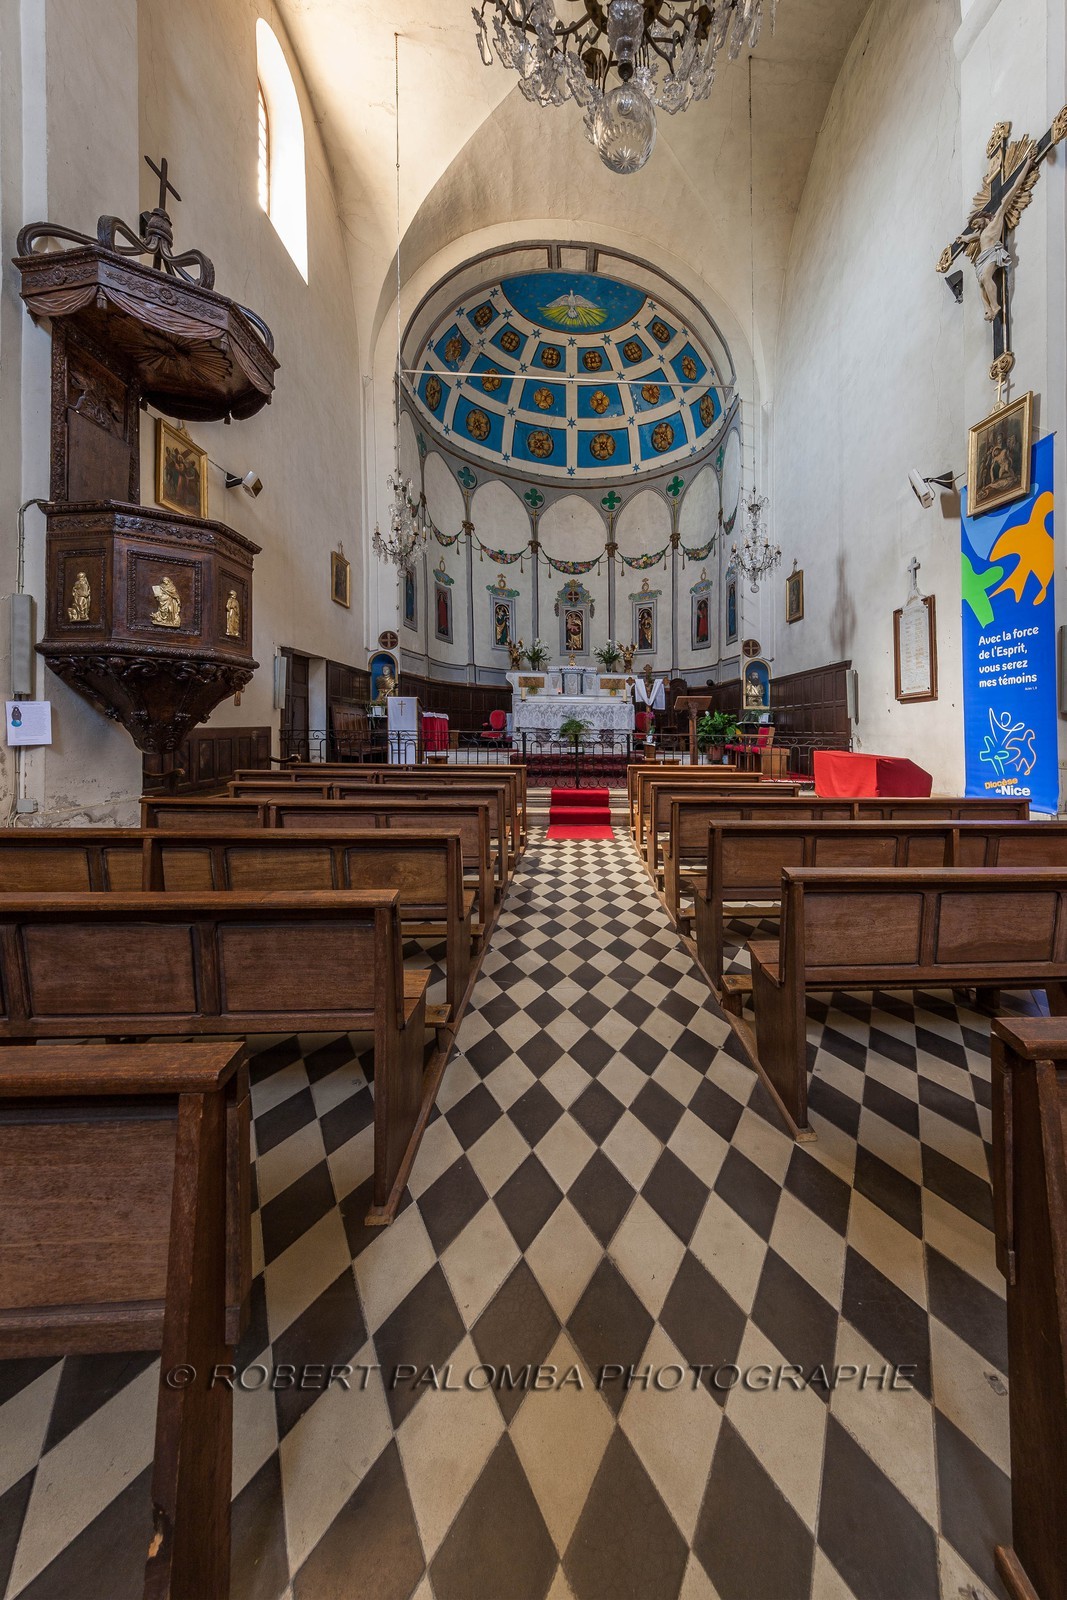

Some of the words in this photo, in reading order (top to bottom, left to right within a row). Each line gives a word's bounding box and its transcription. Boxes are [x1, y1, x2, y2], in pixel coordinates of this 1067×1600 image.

[978, 636, 1001, 646] Avec
[1002, 630, 1012, 641] la
[1012, 626, 1039, 639] force
[978, 650, 990, 660] de
[991, 642, 1028, 658] l'Esprit,
[979, 664, 1000, 674] vous
[1001, 659, 1028, 671] serez
[979, 678, 997, 688] mes
[998, 672, 1038, 686] témoins
[984, 778, 1018, 790] Diocèse
[1001, 785, 1031, 796] Nice
